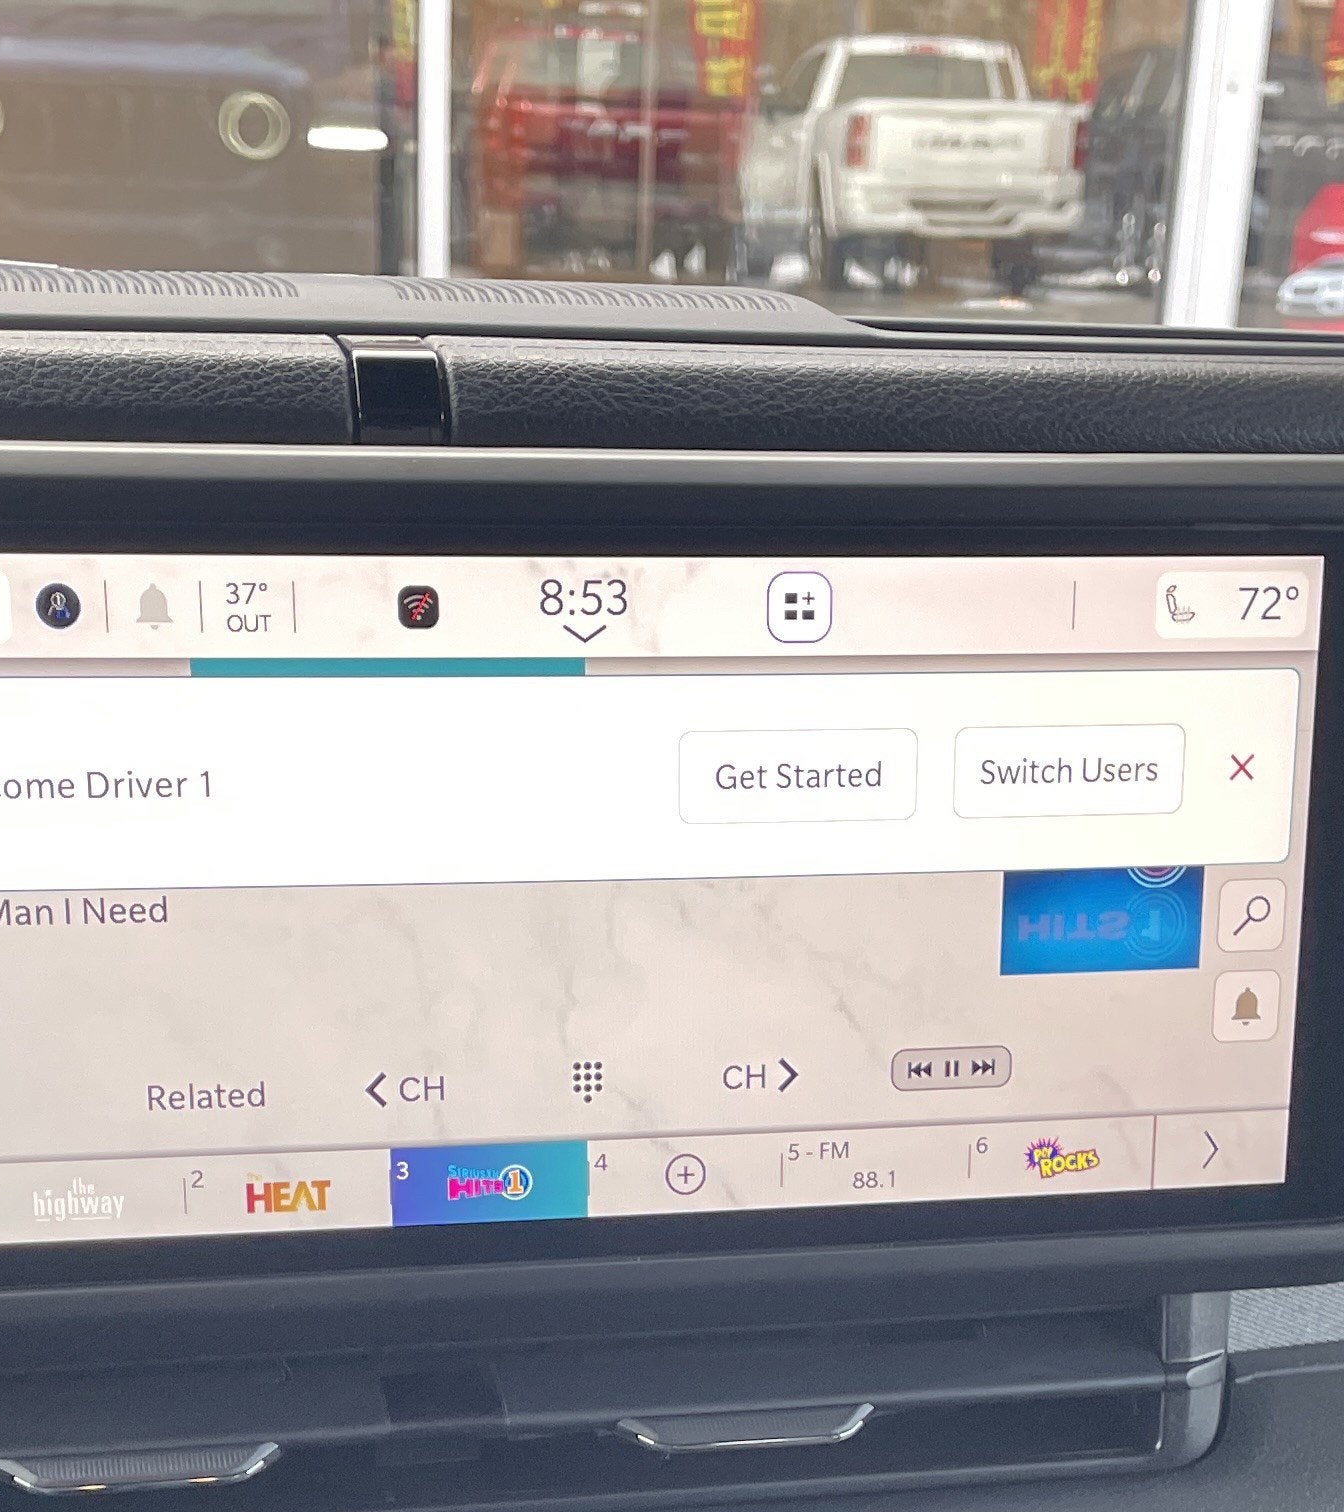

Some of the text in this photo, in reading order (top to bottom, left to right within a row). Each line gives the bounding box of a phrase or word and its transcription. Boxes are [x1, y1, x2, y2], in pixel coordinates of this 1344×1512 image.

[225, 581, 268, 605] 37°
[539, 578, 628, 616] 8:53
[1238, 585, 1300, 621] 72°
[227, 614, 272, 633] OUT
[87, 770, 187, 799] Driver
[199, 770, 212, 798] 1
[715, 761, 882, 790] Get Started
[979, 757, 1158, 786] Switch Users
[64, 898, 72, 925] I
[83, 895, 169, 924] Need
[399, 1076, 445, 1102] CH
[722, 1064, 767, 1090] CH
[147, 1081, 266, 1111] Related
[788, 1143, 800, 1161] 5
[819, 1141, 850, 1160] FM
[975, 1137, 988, 1155] 6
[396, 1161, 409, 1180] 3
[594, 1153, 608, 1171] 4
[1039, 1149, 1099, 1178] ROCKS
[72, 1176, 96, 1195] the
[191, 1170, 205, 1189] 2
[852, 1169, 896, 1189] 88.1
[32, 1189, 125, 1222] highway
[245, 1180, 331, 1214] HEAT
